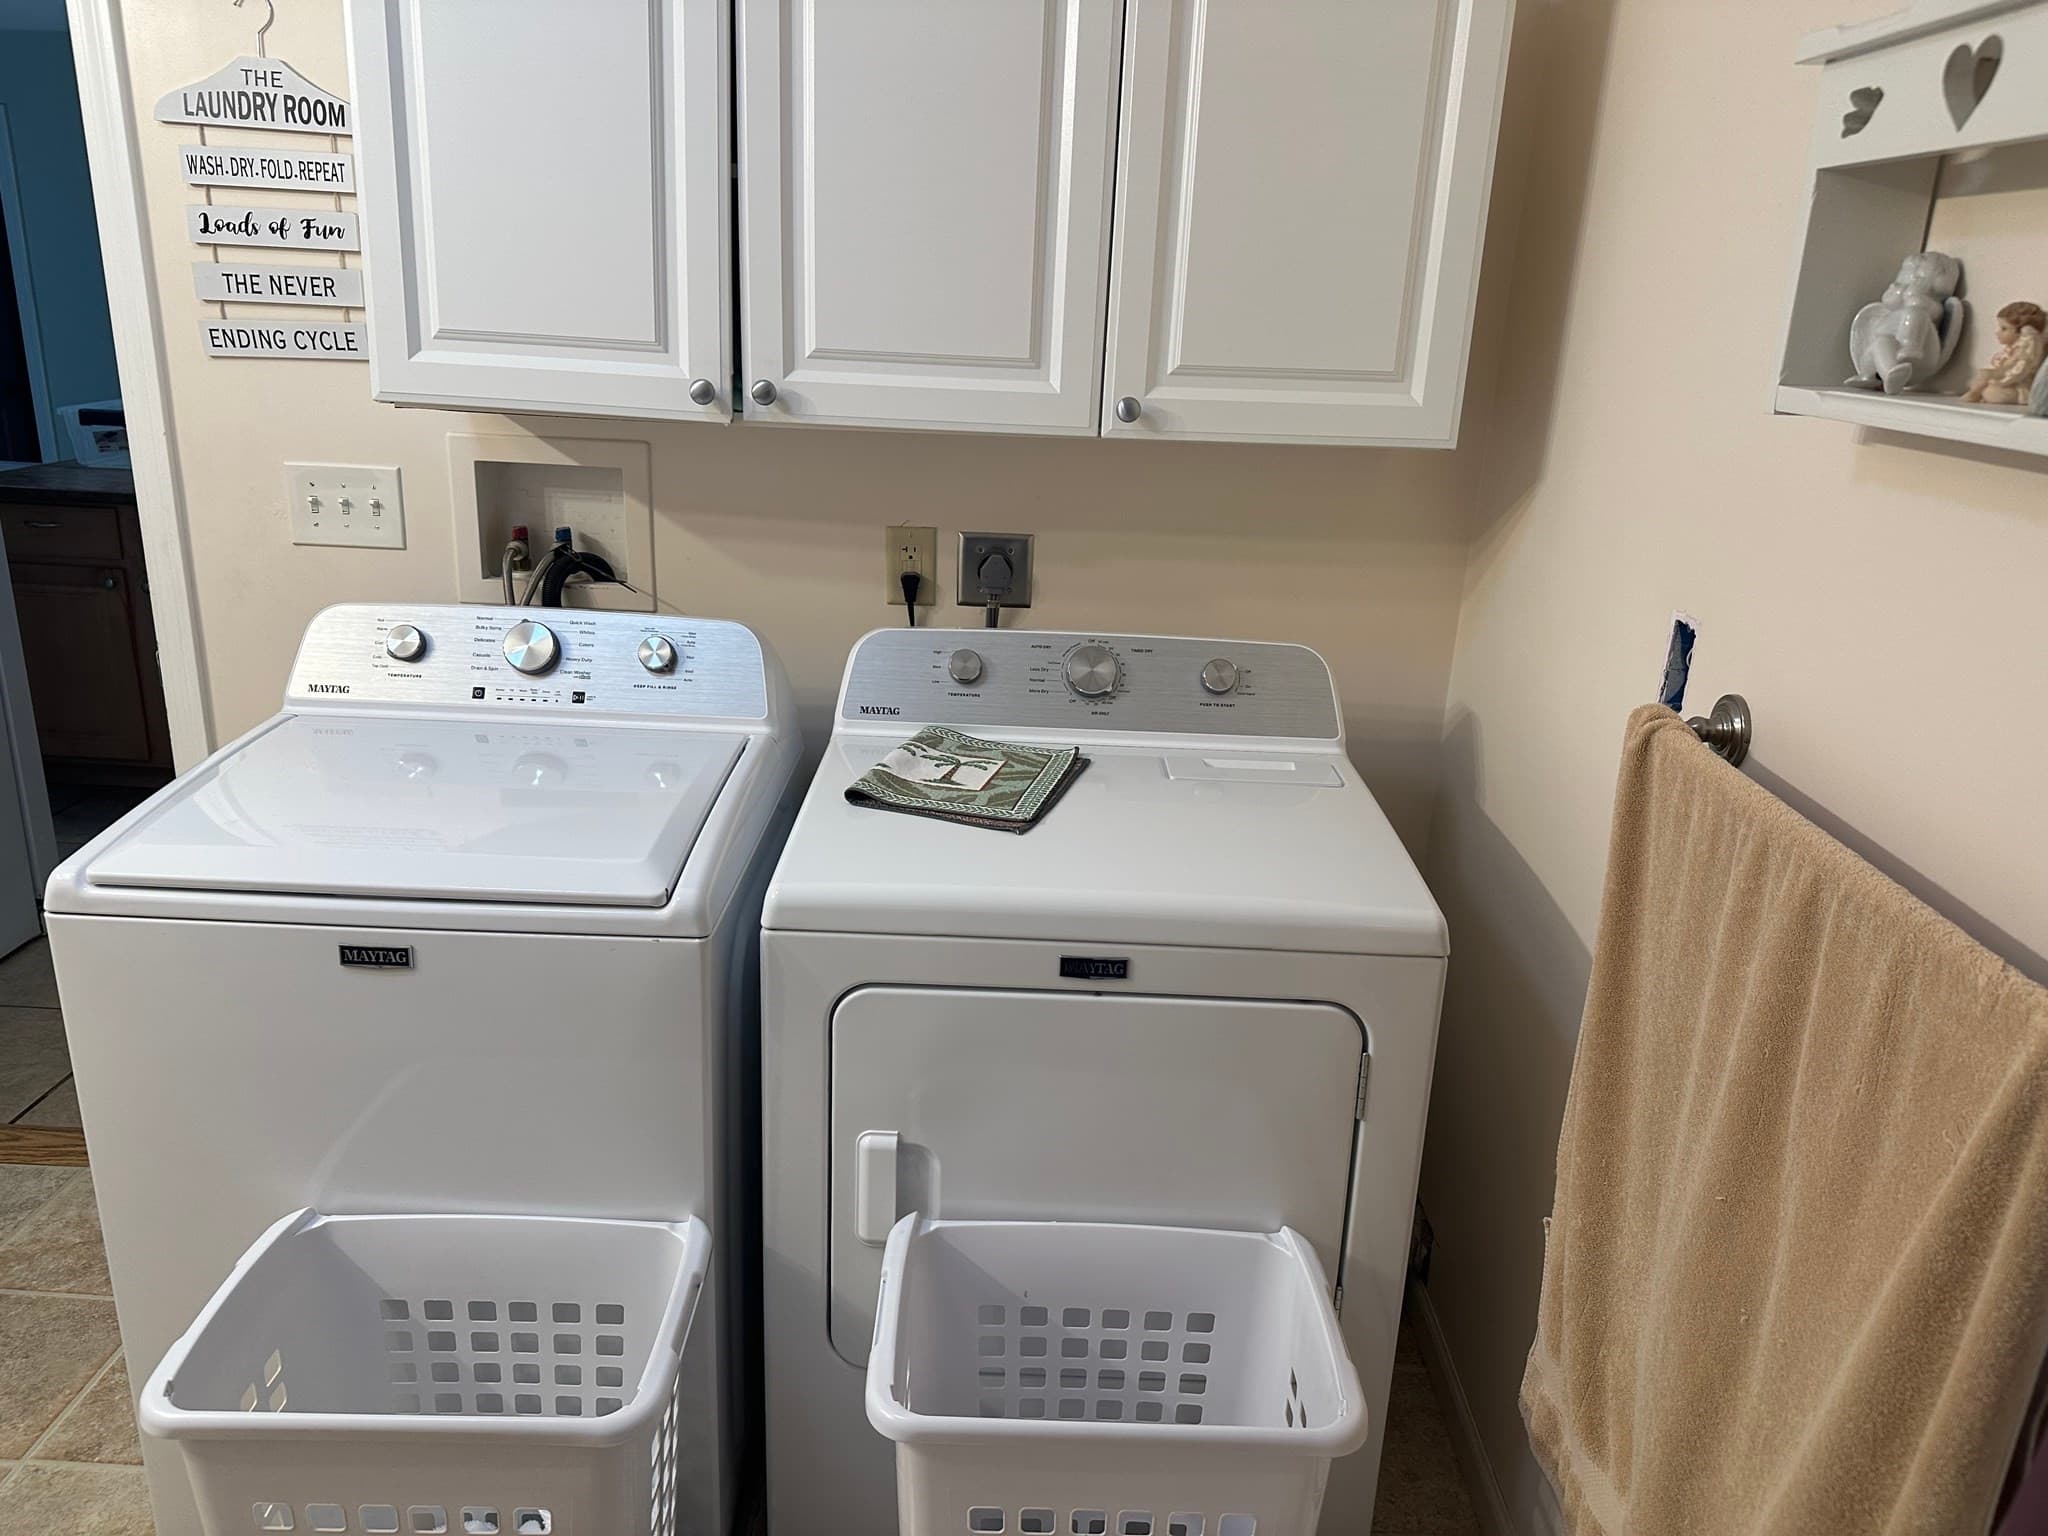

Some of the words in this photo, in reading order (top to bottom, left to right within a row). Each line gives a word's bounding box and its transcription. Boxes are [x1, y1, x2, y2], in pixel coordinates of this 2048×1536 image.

[240, 68, 283, 88] THE
[183, 91, 278, 122] LAUNDRY
[284, 94, 346, 127] ROOM
[198, 212, 261, 236] Loads
[268, 218, 291, 240] of
[300, 217, 345, 240] Fun
[222, 272, 262, 295] THE
[269, 275, 337, 298] NEVER
[208, 327, 286, 350] ENDING
[293, 330, 358, 352] CYCLE
[307, 683, 350, 694] MAYTAG
[859, 706, 900, 716] MAYTAG
[343, 949, 407, 963] MAYTAG
